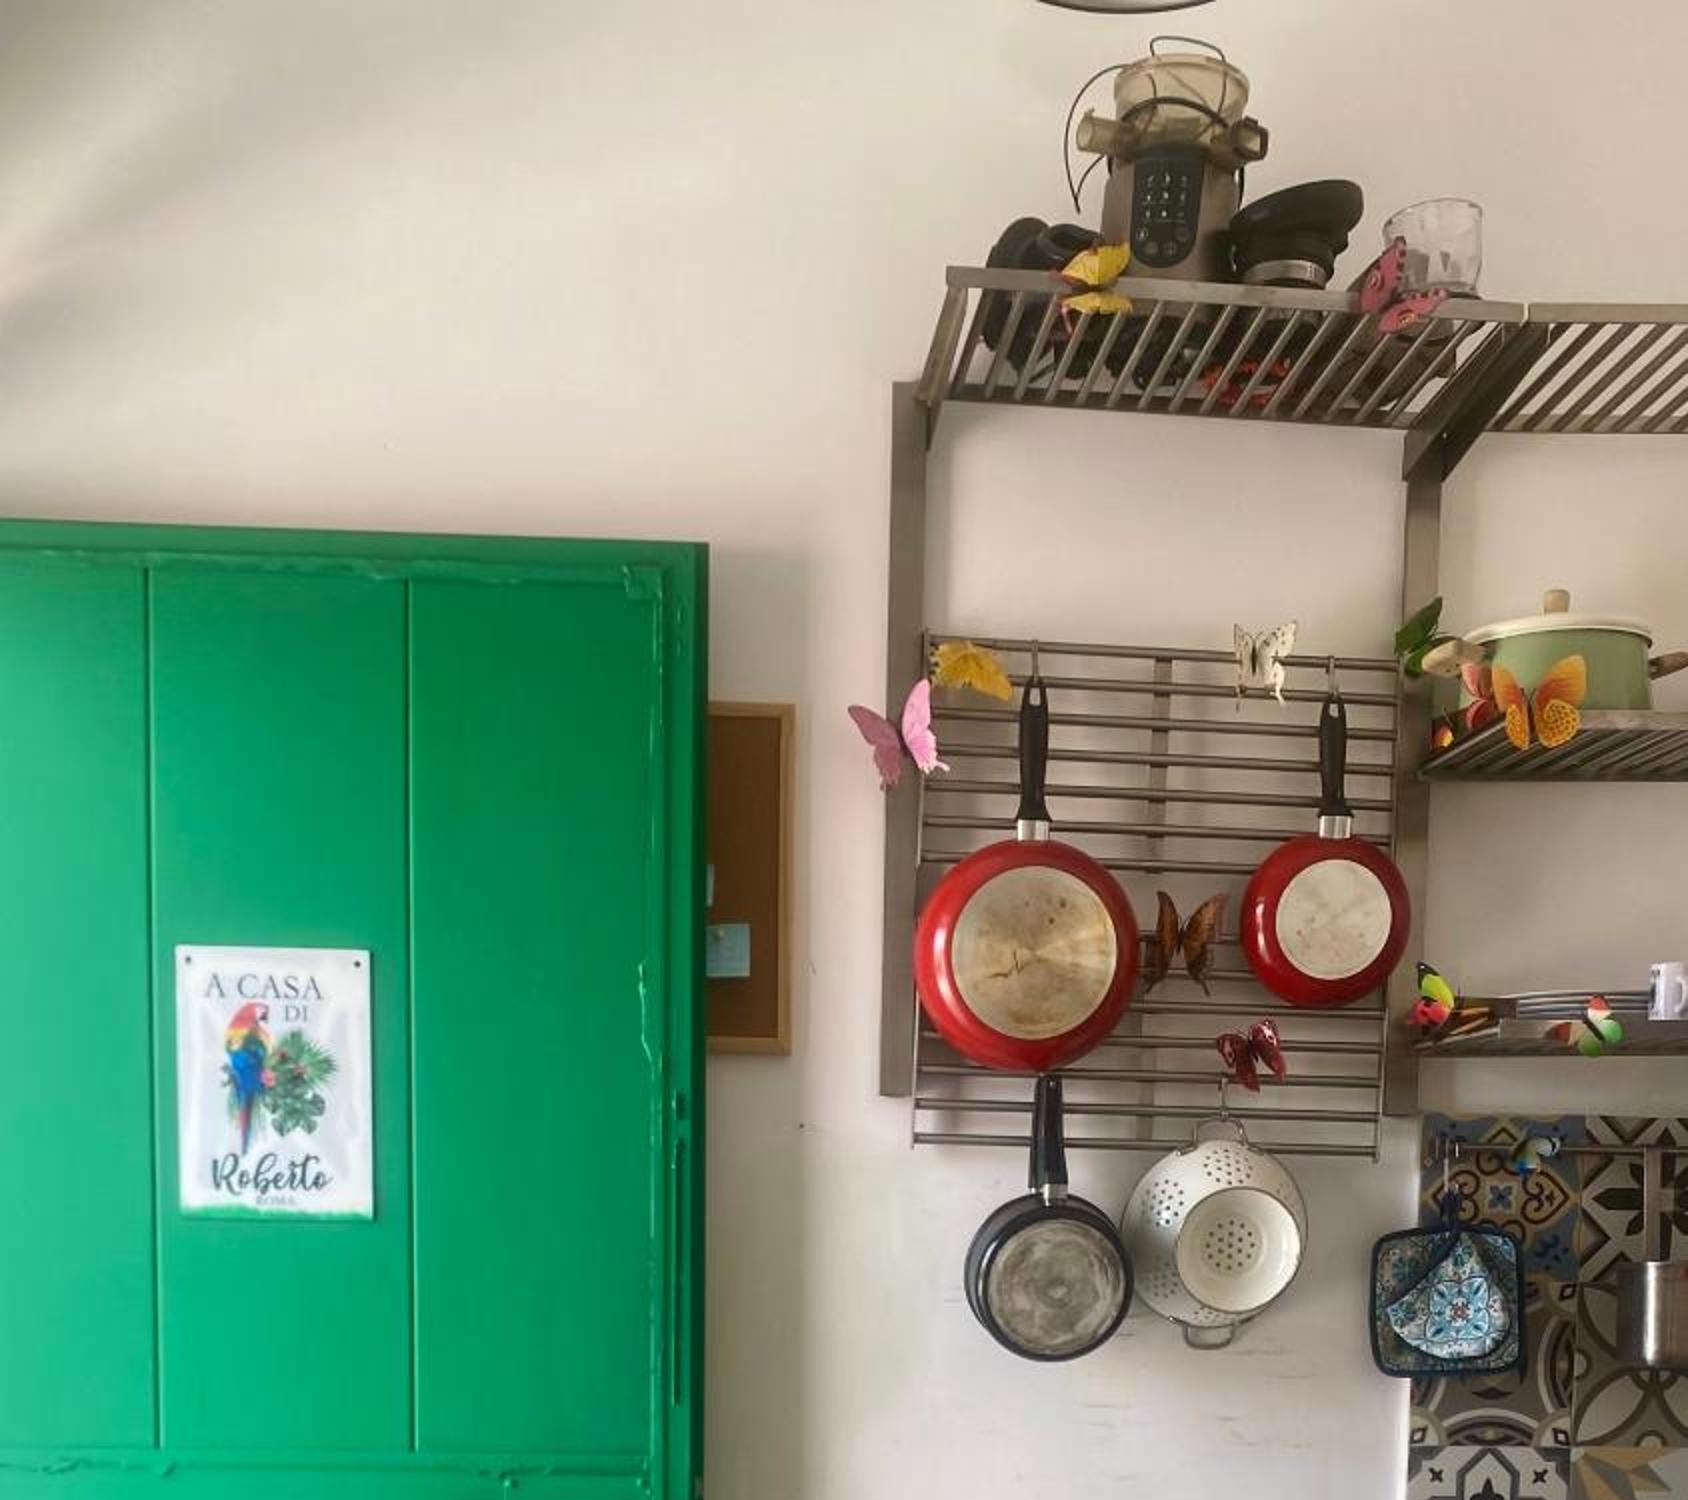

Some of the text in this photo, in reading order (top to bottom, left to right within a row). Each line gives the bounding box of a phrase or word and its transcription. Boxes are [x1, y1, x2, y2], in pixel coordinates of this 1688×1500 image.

[204, 973, 322, 1000] A CASA
[284, 1004, 309, 1022] DI
[211, 1152, 333, 1195] Roberto
